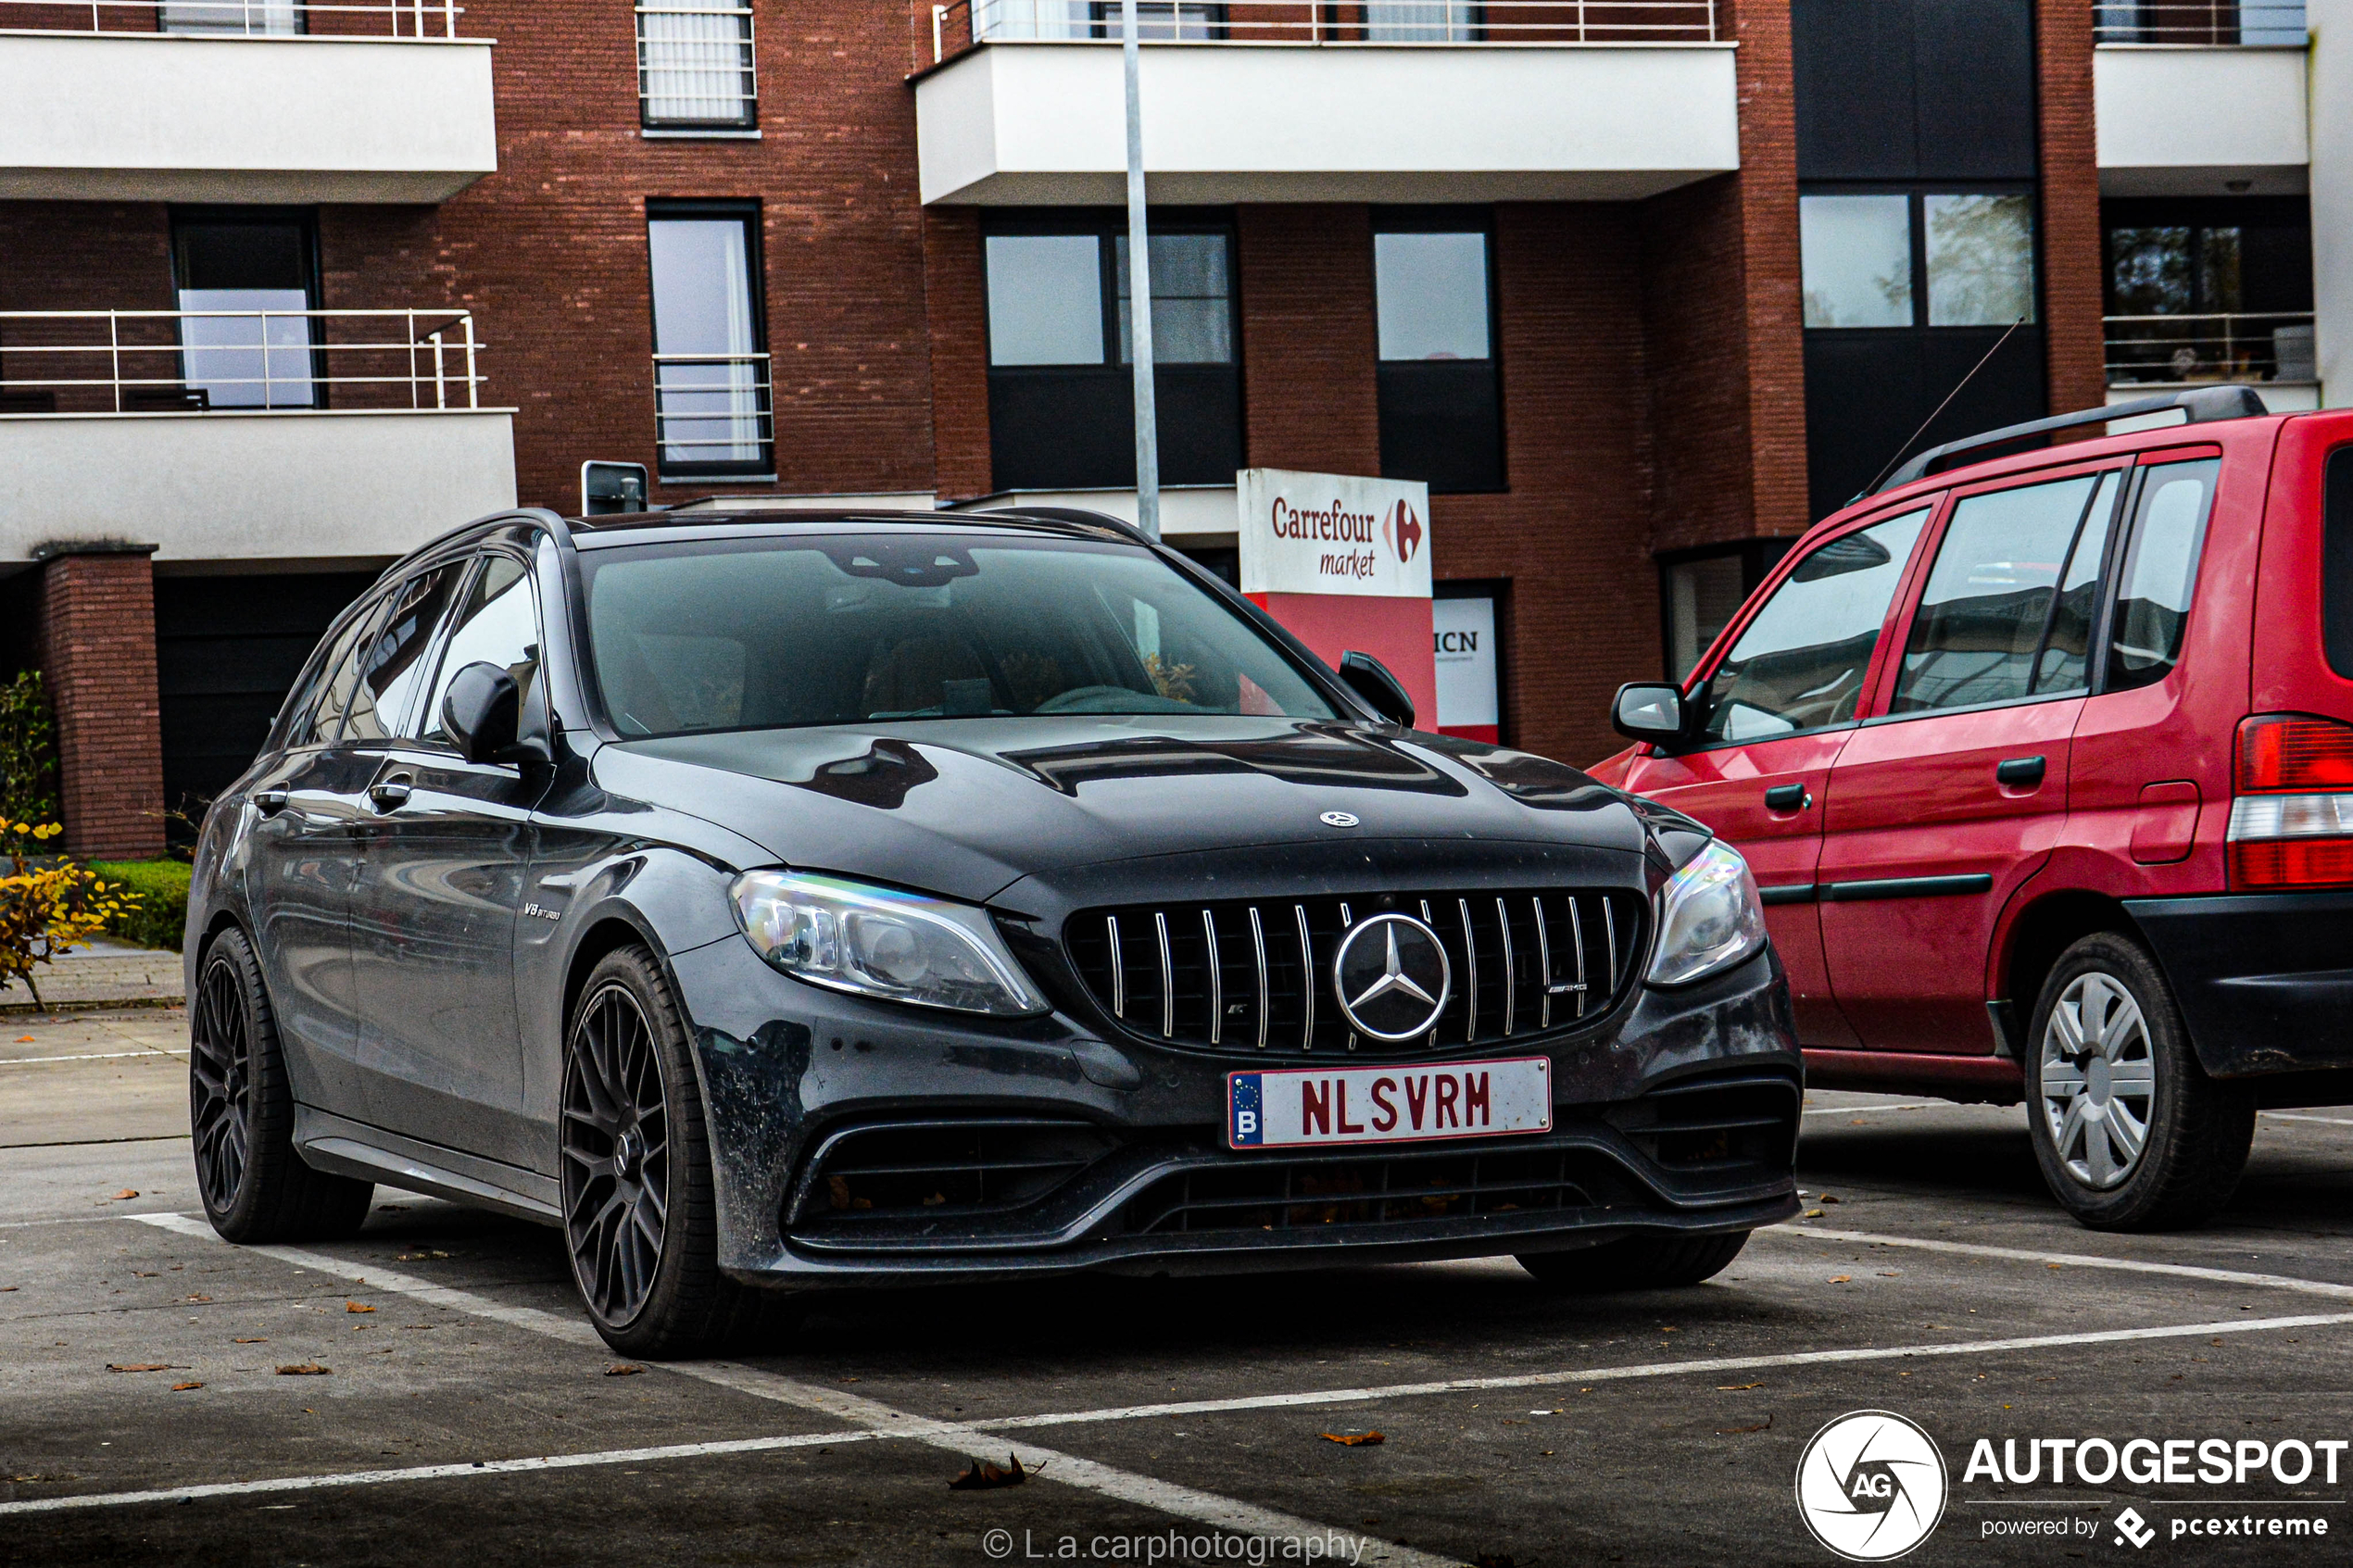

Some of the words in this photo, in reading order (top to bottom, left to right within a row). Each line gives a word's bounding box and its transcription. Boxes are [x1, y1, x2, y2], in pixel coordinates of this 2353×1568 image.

[1272, 496, 1375, 543] Carrefour
[1320, 548, 1376, 580] market
[1433, 632, 1478, 653] ICN
[524, 902, 539, 916] V8
[1302, 1072, 1490, 1135] NLSVRM
[1238, 1110, 1257, 1134] B
